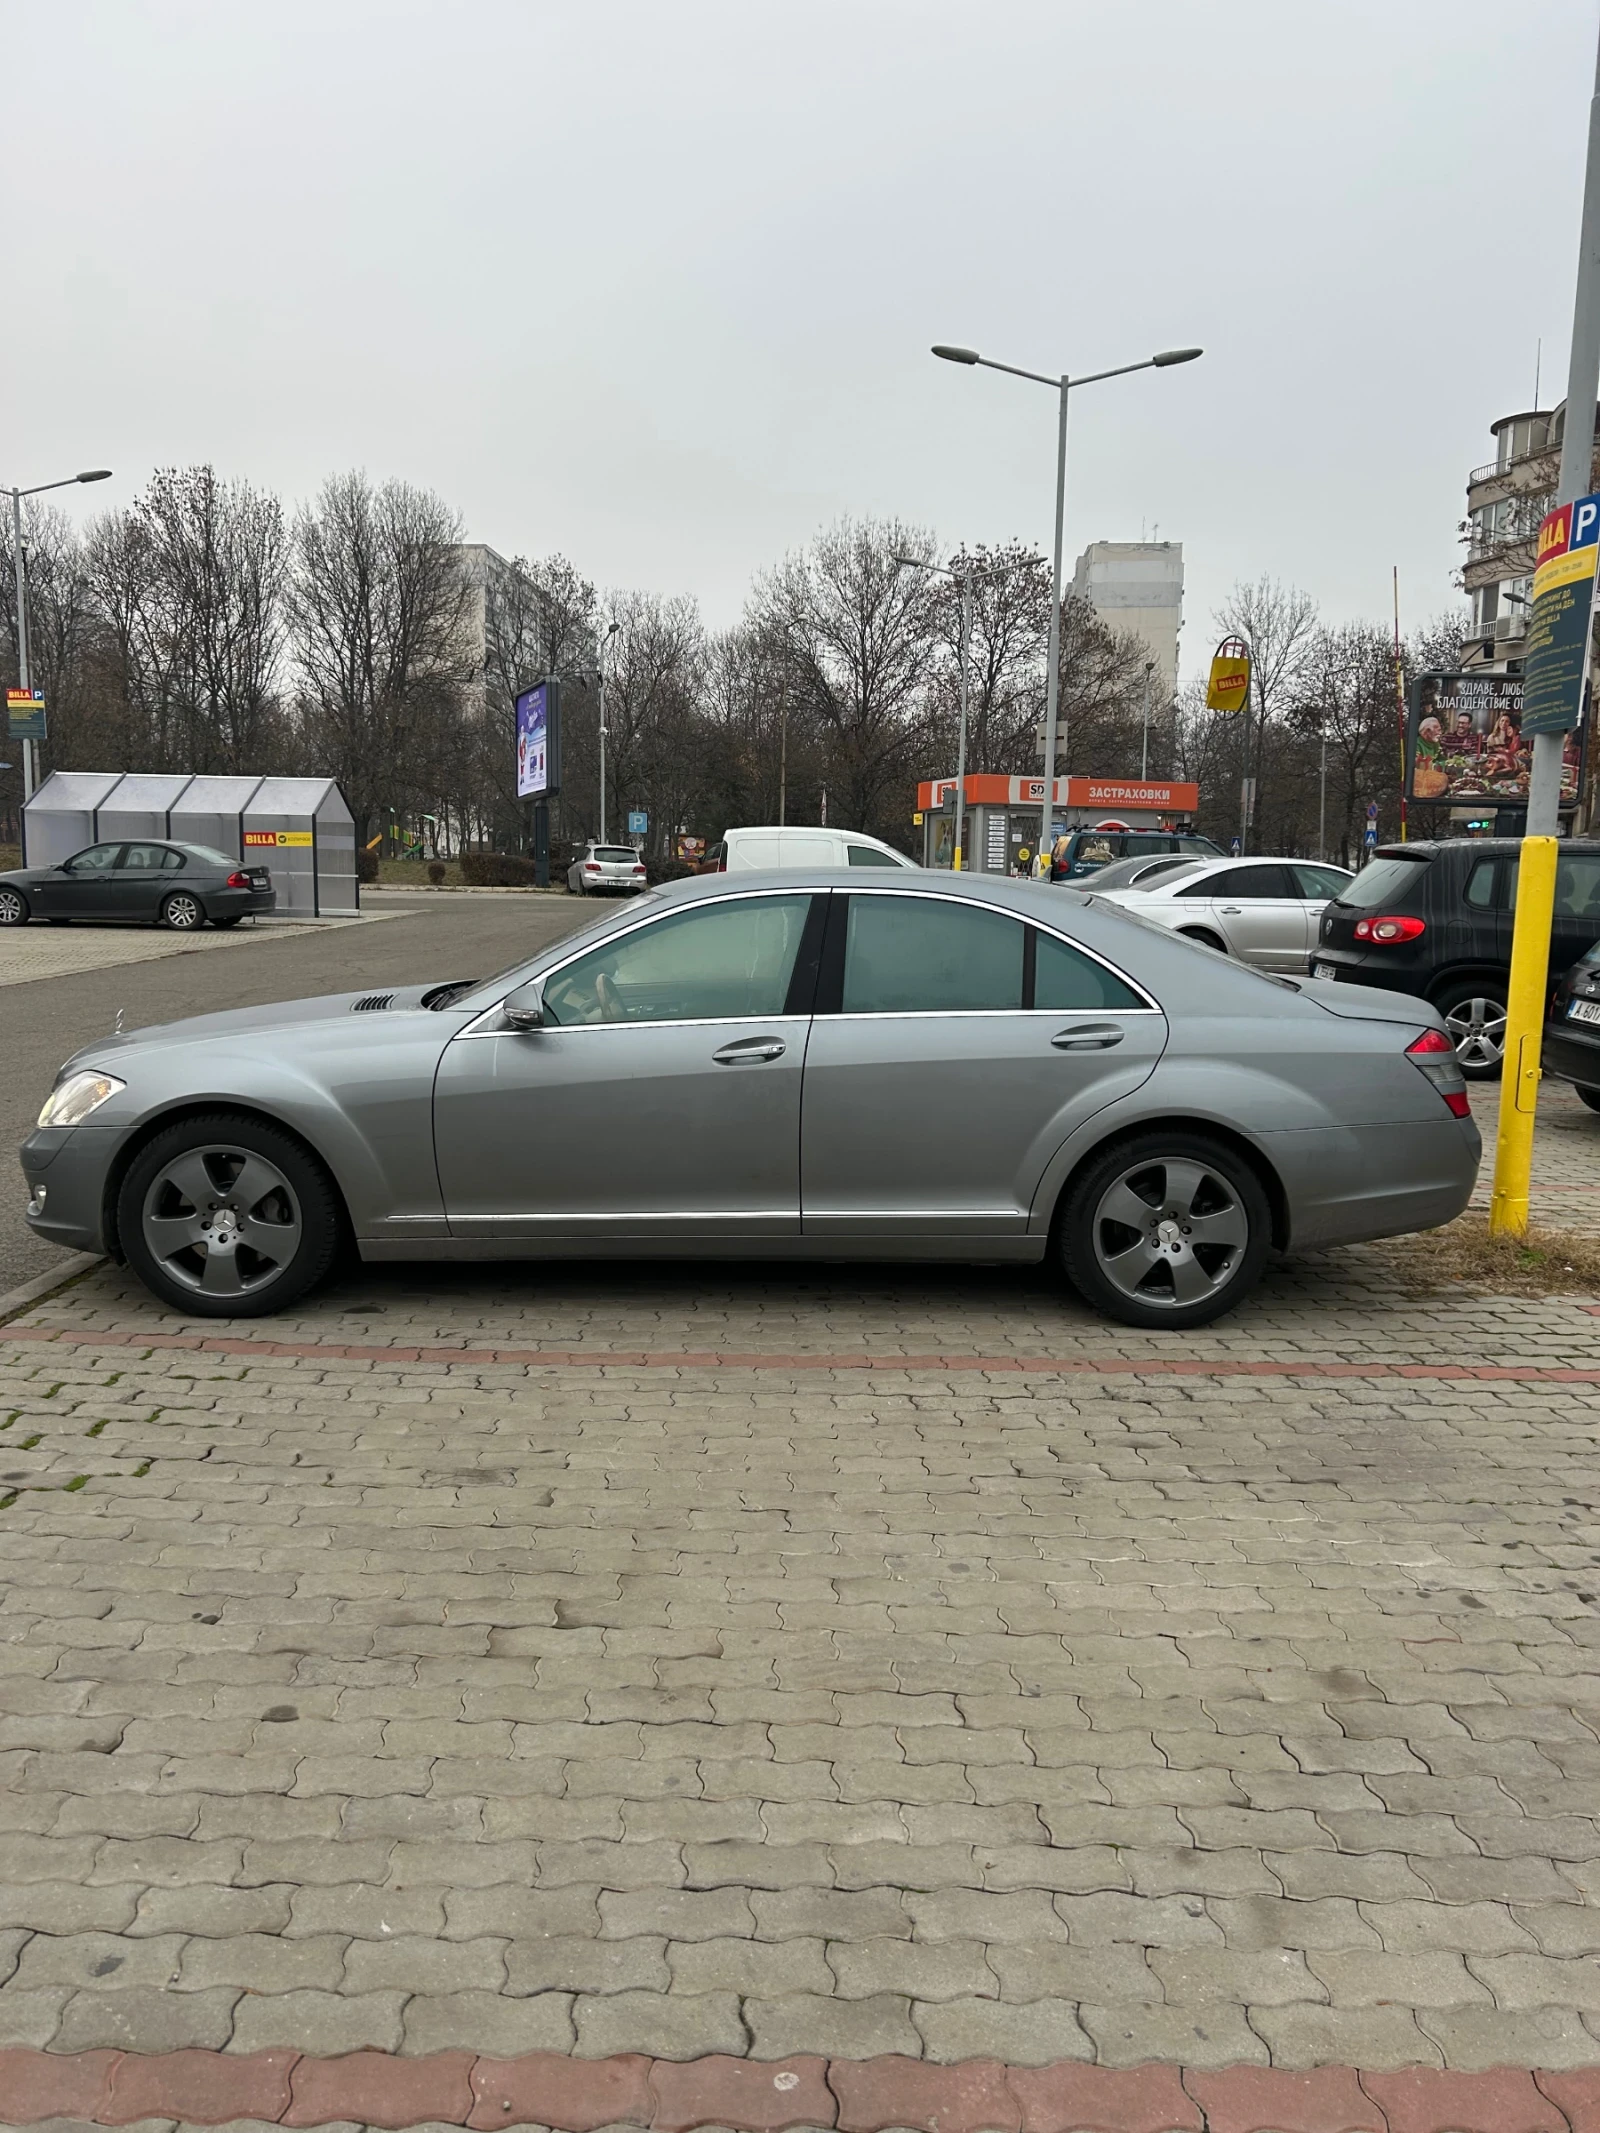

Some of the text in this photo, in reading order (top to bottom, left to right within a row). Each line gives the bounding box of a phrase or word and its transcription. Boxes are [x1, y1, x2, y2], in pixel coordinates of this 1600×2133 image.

[1576, 503, 1597, 541] P
[1218, 676, 1245, 689] BILLA
[1460, 682, 1498, 697] ЗДРАВЕ,
[34, 690, 42, 699] P
[1437, 696, 1511, 710] БЛАГОДЕНСТВИЕ
[1030, 784, 1045, 795] SD
[1089, 786, 1170, 800] ЗАСТРАХОВКИ
[633, 815, 643, 829] P
[245, 834, 275, 844] BILLA
